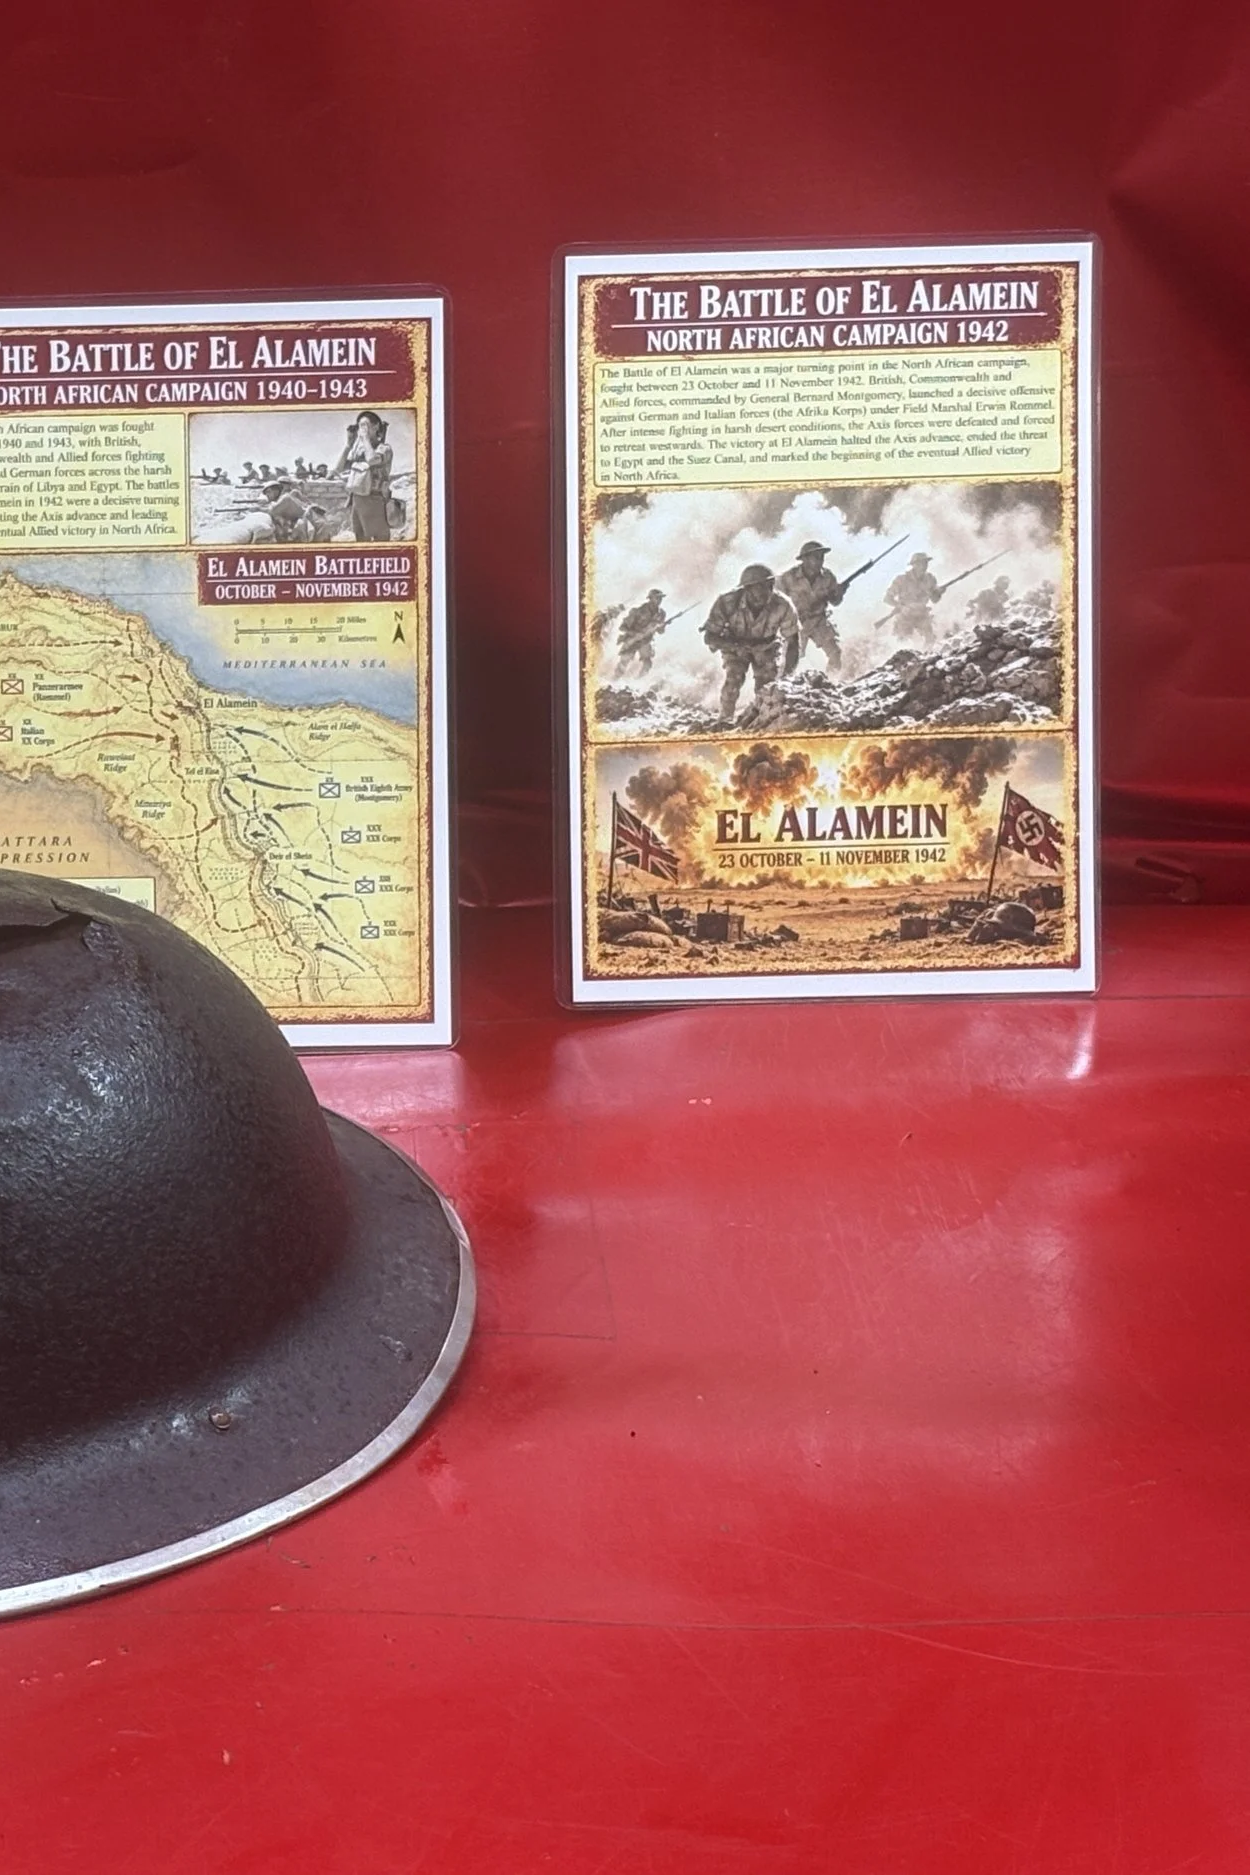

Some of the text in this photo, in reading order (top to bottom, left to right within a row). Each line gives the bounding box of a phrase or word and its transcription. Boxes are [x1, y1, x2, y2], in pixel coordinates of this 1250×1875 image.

[630, 279, 1038, 320] THE BATTLE OF EL ALAMEIN
[647, 319, 1008, 352] NORTH AFRICAN CAMPAIGN 1942
[50, 339, 154, 373] BATTLE
[163, 341, 199, 370] OF
[209, 336, 243, 369] EL
[251, 335, 376, 368] ALAMEIN
[598, 356, 1030, 378] The Battle of El Alamein was a major turning point in the North African campaign,
[53, 383, 138, 404] AFRICAN
[145, 381, 247, 402] CAMPAIGN
[6, 423, 44, 434] African
[46, 422, 96, 436] campaign
[98, 424, 119, 432] was
[121, 420, 154, 434] fought
[24, 437, 44, 448] and
[47, 437, 75, 449] 1943,
[78, 436, 102, 447] with
[104, 435, 141, 448] British,
[208, 555, 410, 577] EL ALAMEIN BATTLEFIELD
[214, 583, 276, 599] OCTOBER
[295, 582, 368, 598] NOVEMBER
[375, 581, 408, 596] 1942
[394, 611, 404, 621] N
[223, 659, 387, 669] MEDITERRANEAN SEA
[204, 698, 258, 708] El Alamein
[716, 804, 947, 843] EL ALAMEIN
[718, 853, 735, 869] 23
[739, 851, 803, 868] OCTOBER
[819, 851, 830, 866] 11
[836, 849, 910, 865] NOVEMBER
[914, 847, 946, 863] 1942
